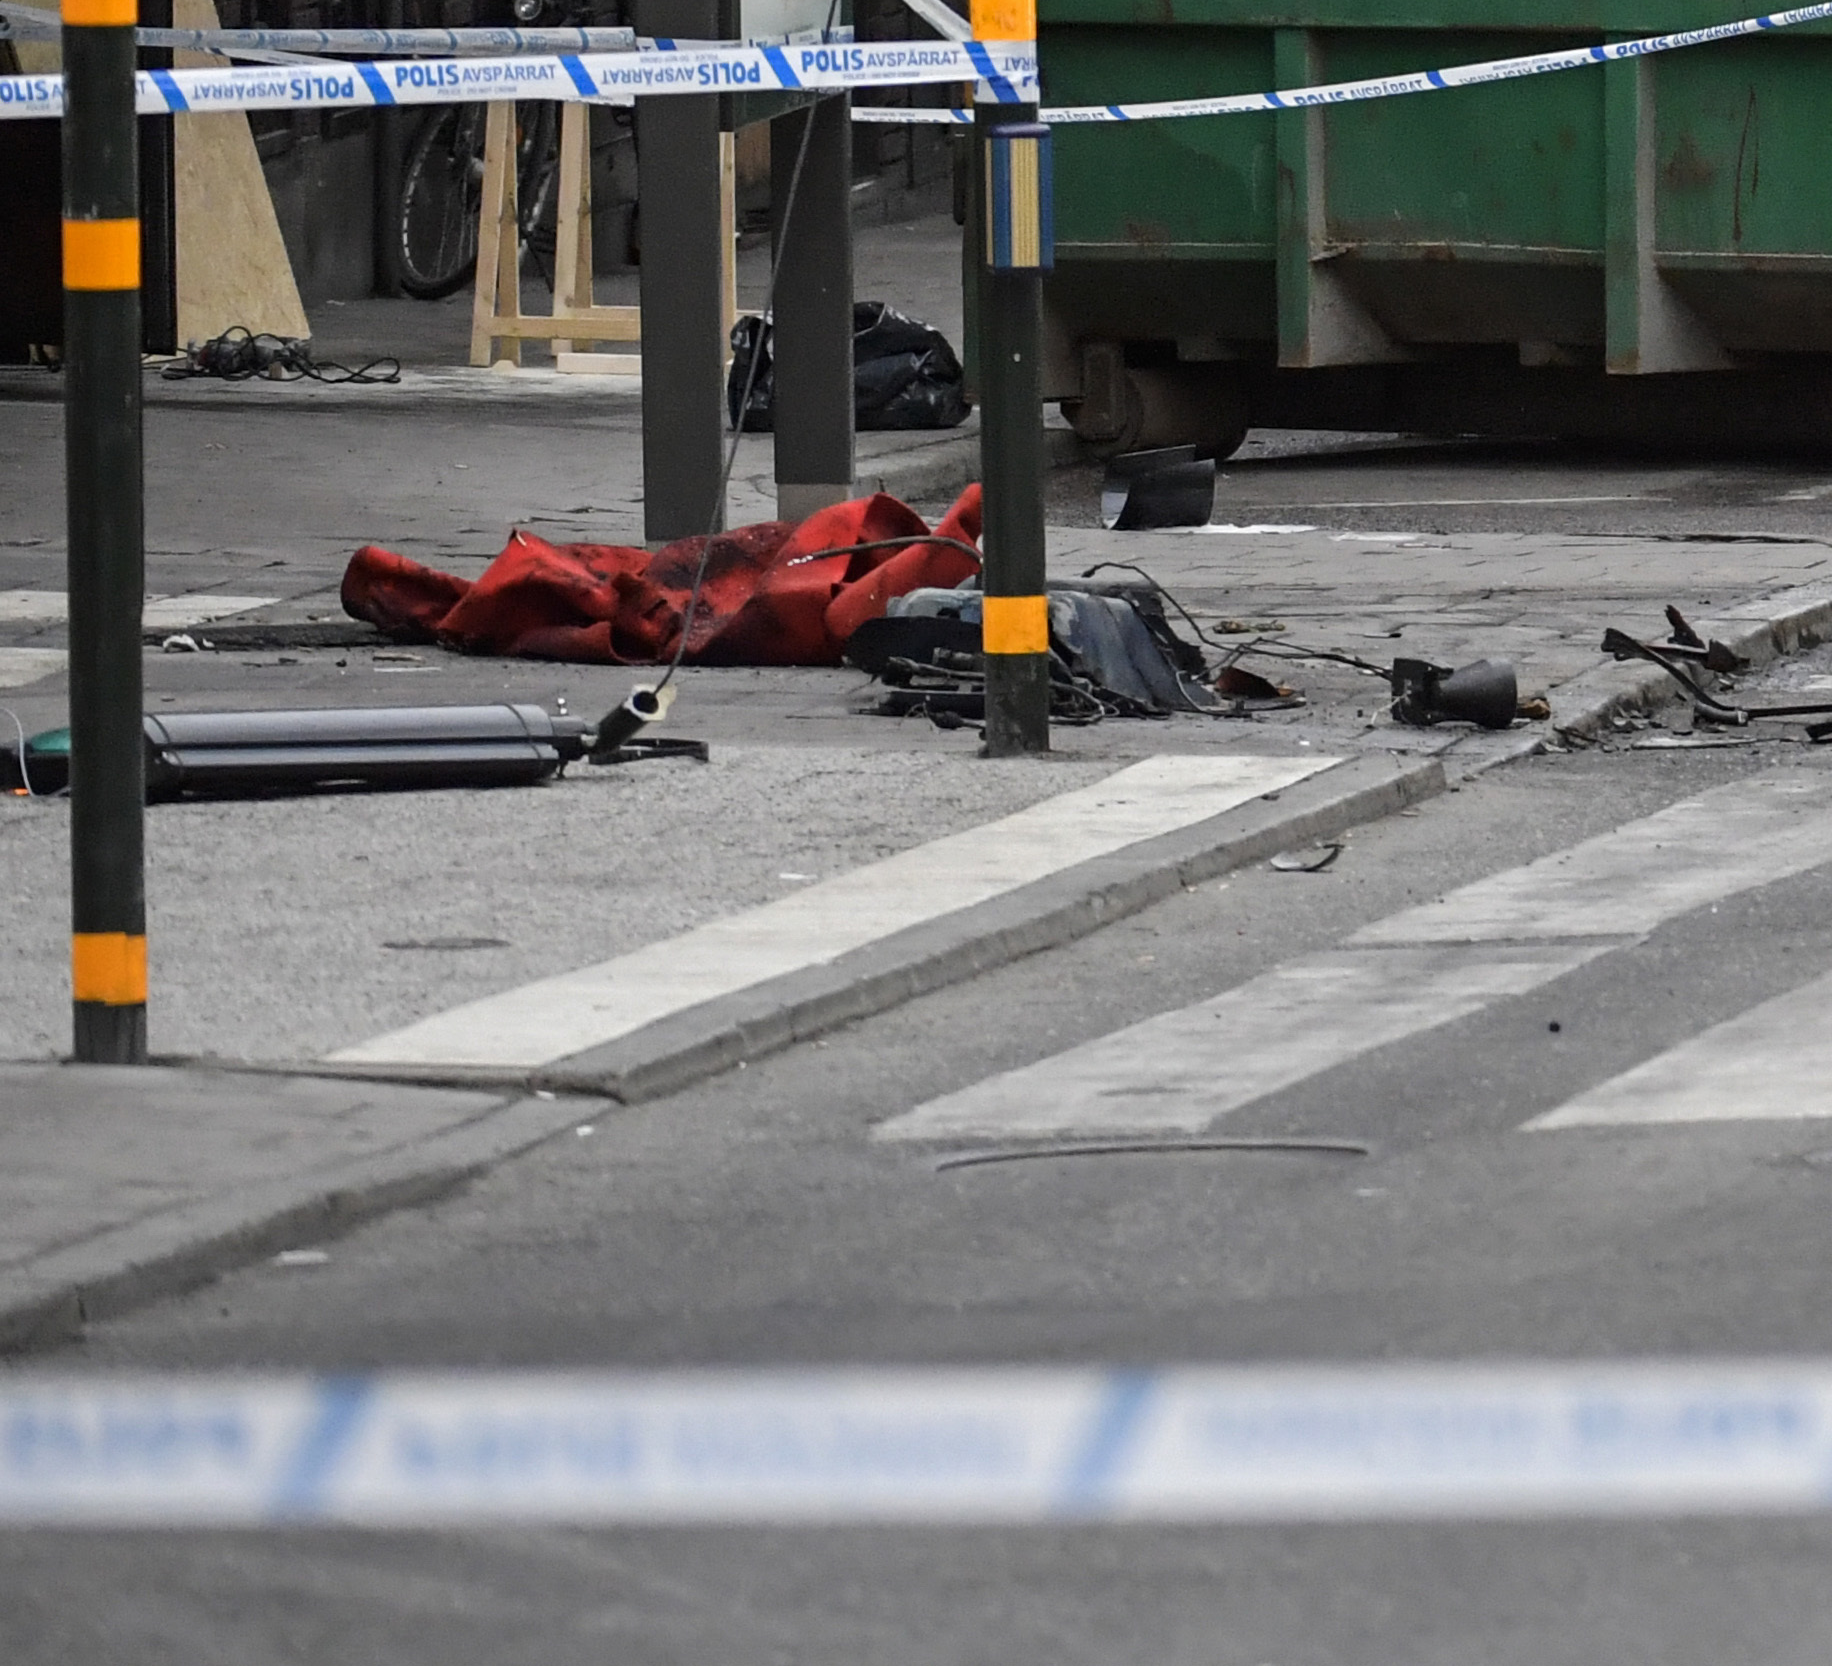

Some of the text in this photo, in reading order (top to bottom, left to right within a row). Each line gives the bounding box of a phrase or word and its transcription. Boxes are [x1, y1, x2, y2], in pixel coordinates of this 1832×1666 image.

[602, 60, 761, 87] POLIS AVSPÄRRAT
[800, 48, 961, 73] POLIS AVSPÄRRAT
[394, 61, 557, 88] POLIS AVSPÄRRAT
[0, 78, 49, 102] OLIS
[192, 75, 356, 102] POLIS AVSPÄRRAT
